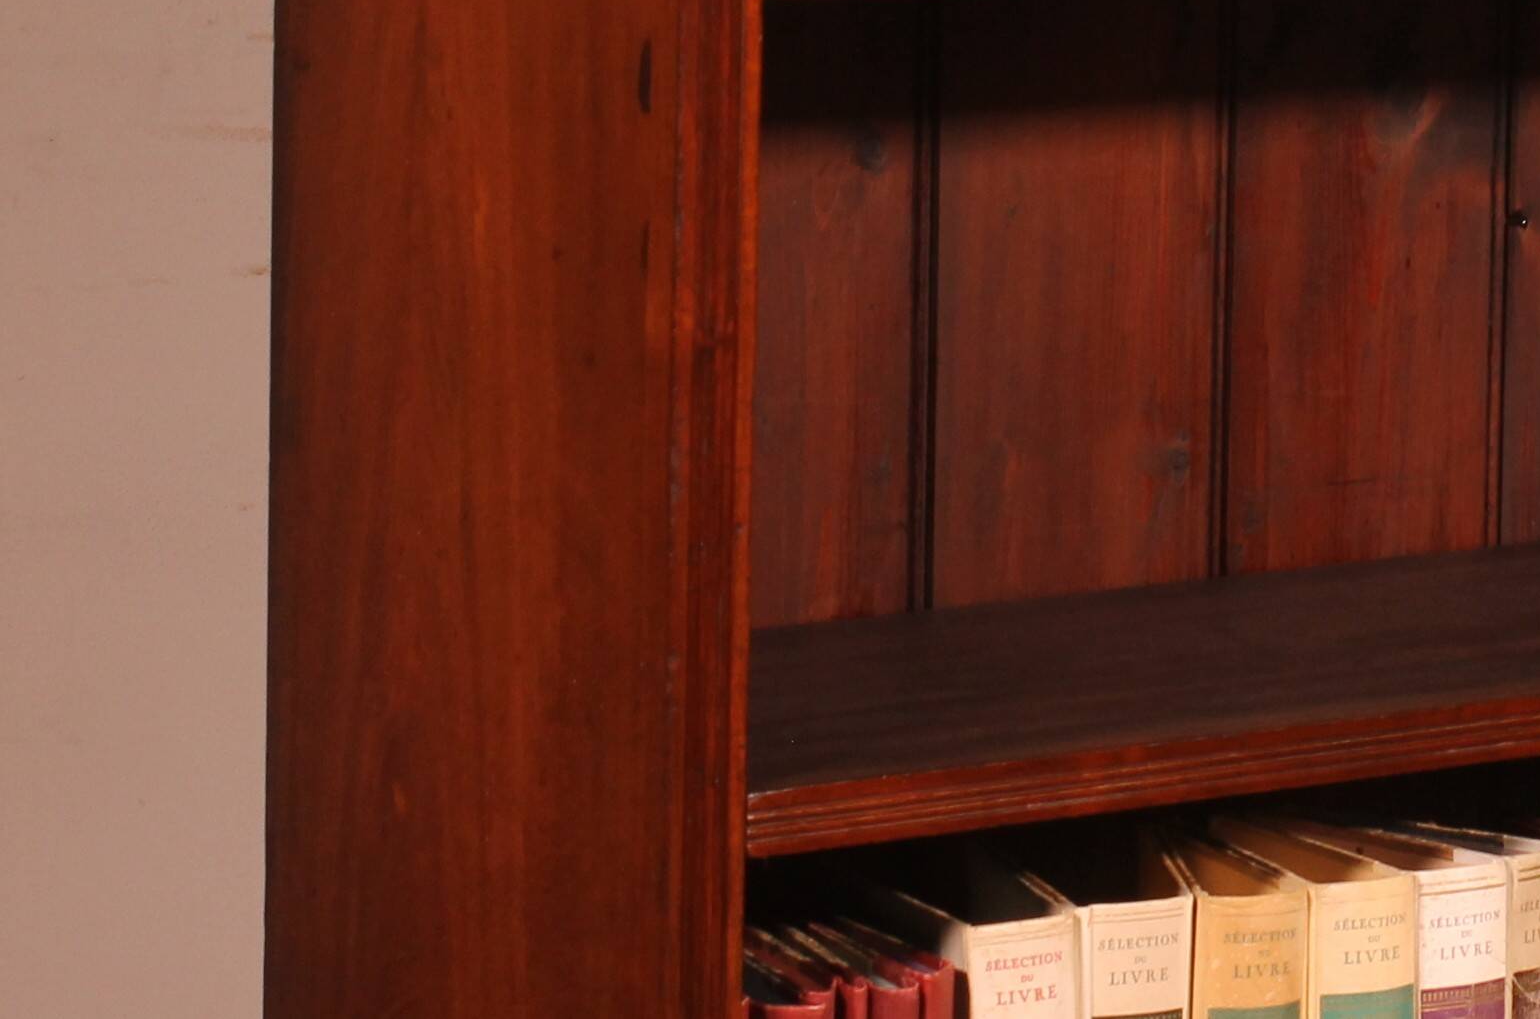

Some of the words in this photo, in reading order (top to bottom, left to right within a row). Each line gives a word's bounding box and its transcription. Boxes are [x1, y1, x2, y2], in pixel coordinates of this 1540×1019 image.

[1343, 945, 1401, 965] LIVRE
[1440, 940, 1493, 961] LIVRE
[1020, 973, 1034, 983] DU
[1109, 966, 1169, 987] LIVRE
[1233, 961, 1290, 979] LIVRE
[996, 984, 1057, 1007] LIVRE
